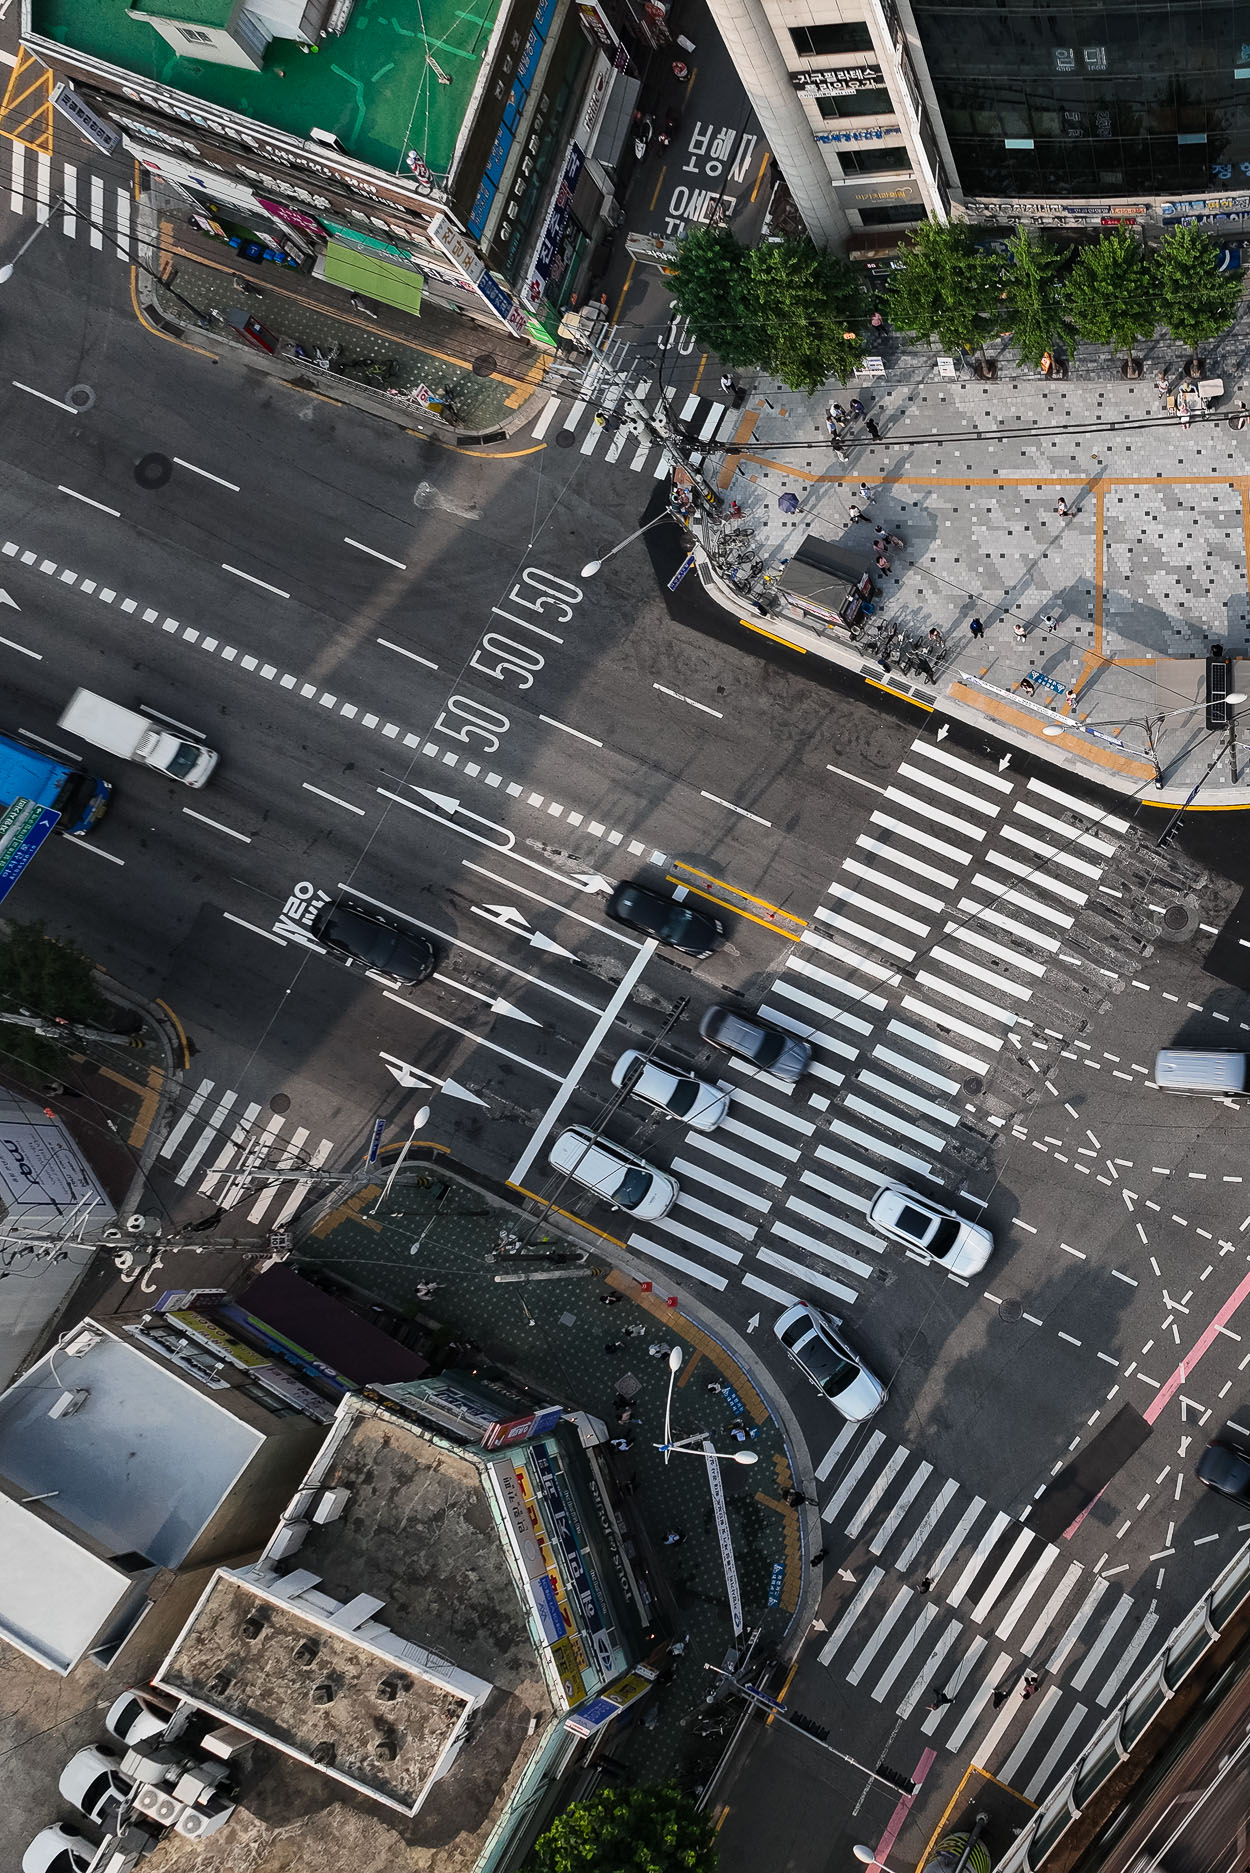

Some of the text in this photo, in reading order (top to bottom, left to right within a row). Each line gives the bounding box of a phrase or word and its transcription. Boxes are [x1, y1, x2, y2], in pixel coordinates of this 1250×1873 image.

[797, 68, 877, 84] 지구필라테스
[682, 121, 757, 183] 보행자
[540, 151, 582, 265] 진주약국
[508, 566, 585, 624] 50
[469, 631, 546, 690] 50
[434, 694, 512, 754] 50
[502, 1476, 528, 1534] 만화카페
[588, 1479, 614, 1536] JOURS
[541, 1470, 598, 1618] 혜민치과
[611, 1554, 635, 1603] TOUS
